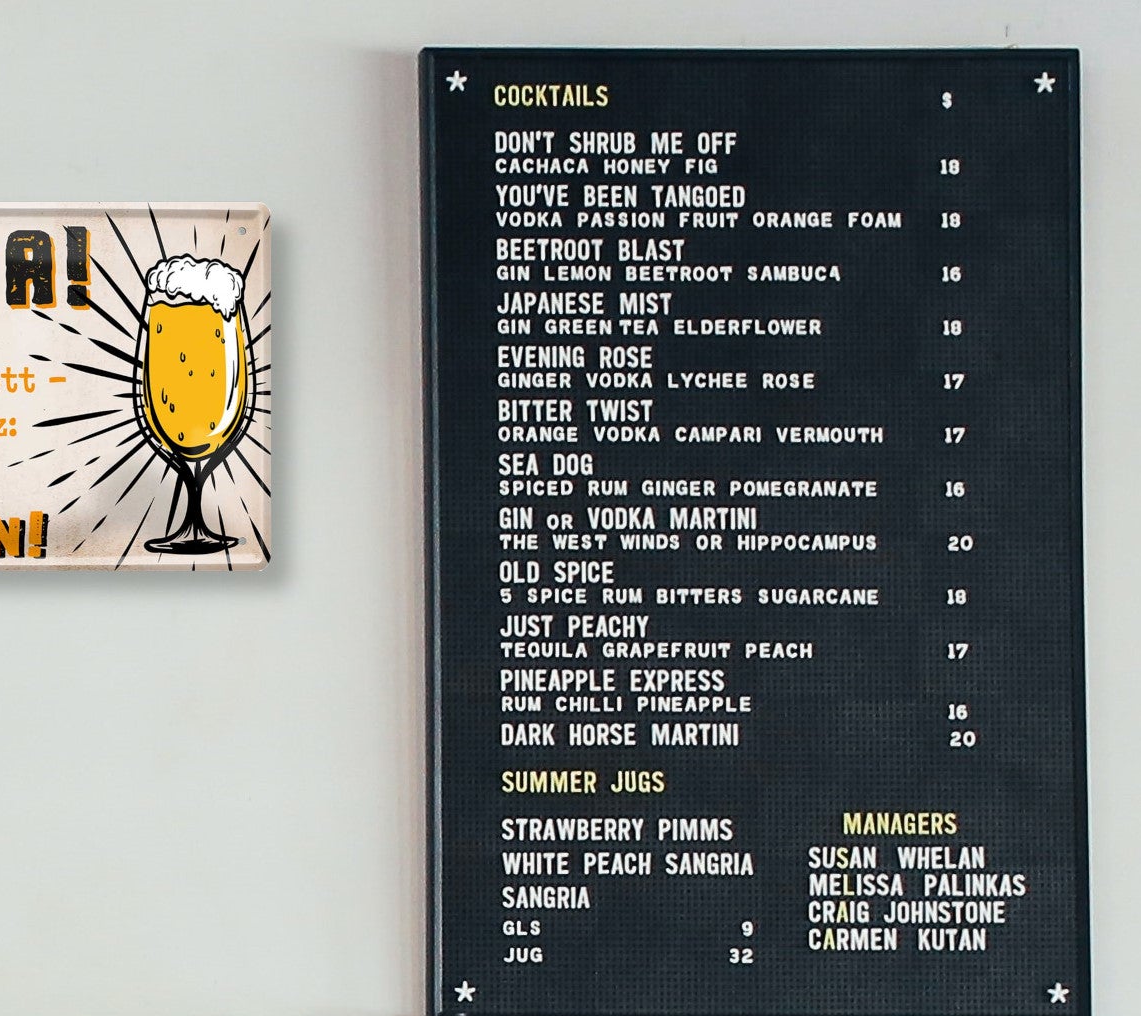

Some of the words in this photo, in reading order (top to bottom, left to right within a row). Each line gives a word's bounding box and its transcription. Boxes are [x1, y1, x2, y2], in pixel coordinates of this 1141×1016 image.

[494, 84, 609, 107] COCKTAILS
[494, 130, 555, 154] DON'T
[569, 131, 636, 155] SHRUB
[650, 131, 683, 155] ME
[697, 131, 737, 155] OFF
[495, 157, 589, 175] CACHACA
[603, 158, 671, 175] HONEY
[685, 158, 718, 175] FIG
[940, 158, 960, 176] 18
[495, 183, 569, 208] YOU'VE
[583, 184, 637, 208] BEEN
[650, 184, 746, 209] TANGOED
[495, 211, 563, 228] VODKA
[577, 211, 665, 228] PASSION
[679, 211, 739, 229] FRUIT
[752, 211, 833, 229] ORANGE
[848, 211, 902, 229] FOAM
[941, 212, 961, 229] 18
[496, 238, 604, 262] BEETROOT
[618, 238, 685, 262] BLAST
[496, 265, 530, 282] GIN
[544, 265, 612, 282] LEMON
[625, 265, 733, 282] BEETROOT
[747, 265, 841, 282] SAMBUCA
[941, 266, 962, 283] 16
[496, 291, 605, 315] JAPANESE
[619, 292, 672, 316] MIST
[497, 318, 531, 335] GIN
[544, 318, 613, 336] GREEN
[618, 319, 659, 336] TEA
[673, 318, 822, 336] ELDERFLOWER
[942, 319, 962, 336] 18
[497, 345, 585, 369] EVENING
[599, 345, 653, 370] ROSE
[497, 372, 572, 389] GINGER
[585, 372, 653, 389] VODKA
[667, 372, 748, 389] LYCHEE
[762, 372, 815, 390] ROSE
[943, 373, 965, 390] 17
[498, 399, 573, 423] BITTER
[585, 399, 653, 423] TWIST
[497, 425, 578, 443] ORANGE
[593, 425, 661, 443] VODKA
[674, 426, 762, 443] CAMPARI
[776, 426, 884, 444] VERMOUTH
[944, 427, 966, 444] 17
[498, 453, 539, 476] SEA
[552, 453, 594, 476] DOG
[499, 479, 574, 497] SPICED
[587, 480, 628, 497] RUM
[641, 479, 716, 497] GINGER
[729, 480, 878, 498] POMEGRANATE
[945, 480, 965, 498] 16
[499, 506, 533, 530] GIN
[546, 513, 574, 531] OR
[586, 506, 656, 530] VODKA
[669, 506, 757, 531] MARTINI
[499, 533, 539, 551] THE
[552, 533, 608, 551] WEST
[619, 533, 680, 551] WINDS
[695, 534, 723, 551] OR
[737, 534, 877, 552] HIPPOCAMPUS
[947, 535, 974, 552] 20
[499, 560, 540, 584] OLD
[553, 560, 614, 584] SPICE
[499, 587, 512, 604] 5
[527, 587, 587, 605] SPICE
[602, 587, 643, 605] RUM
[656, 587, 742, 605] BITTERS
[758, 588, 879, 606] SUGARCANE
[947, 588, 967, 605] 18
[499, 614, 554, 638] JUST
[567, 614, 649, 639] PEACHY
[500, 641, 588, 659] TEQUILA
[602, 641, 731, 659] GRAPEFRUIT
[745, 642, 813, 659] PEACH
[947, 643, 969, 660] 17
[500, 668, 616, 693] PINEAPPLE
[630, 669, 725, 693] EXPRESS
[501, 695, 542, 712] RUM
[555, 695, 623, 713] CHILLI
[637, 695, 752, 713] PINEAPPLE
[947, 703, 968, 721] 16
[501, 722, 555, 747] DARK
[569, 722, 637, 747] HORSE
[651, 722, 739, 747] MARTINI
[949, 730, 977, 748] 20
[501, 770, 597, 794] SUMMER
[610, 770, 665, 793] JUGS
[501, 817, 644, 842] STRAWBERRY
[658, 818, 734, 842] PIMMS
[843, 812, 958, 836] MANAGERS
[502, 851, 570, 876] WHITE
[583, 851, 652, 876] PEACH
[665, 852, 754, 876] SANGRIA
[808, 845, 877, 870] SUSAN
[897, 846, 985, 870] WHELAN
[809, 873, 904, 897] MELISSA
[924, 873, 1027, 898] PALINKAS
[502, 885, 591, 910] SANGRIA
[808, 900, 870, 924] CRAIG
[883, 900, 1006, 924] JOHNSTONE
[502, 920, 541, 936] GLS
[741, 920, 754, 937] 9
[808, 927, 898, 951] CARMEN
[918, 927, 986, 952] KUTAN
[503, 946, 543, 963] JUG
[729, 947, 754, 964] 32
